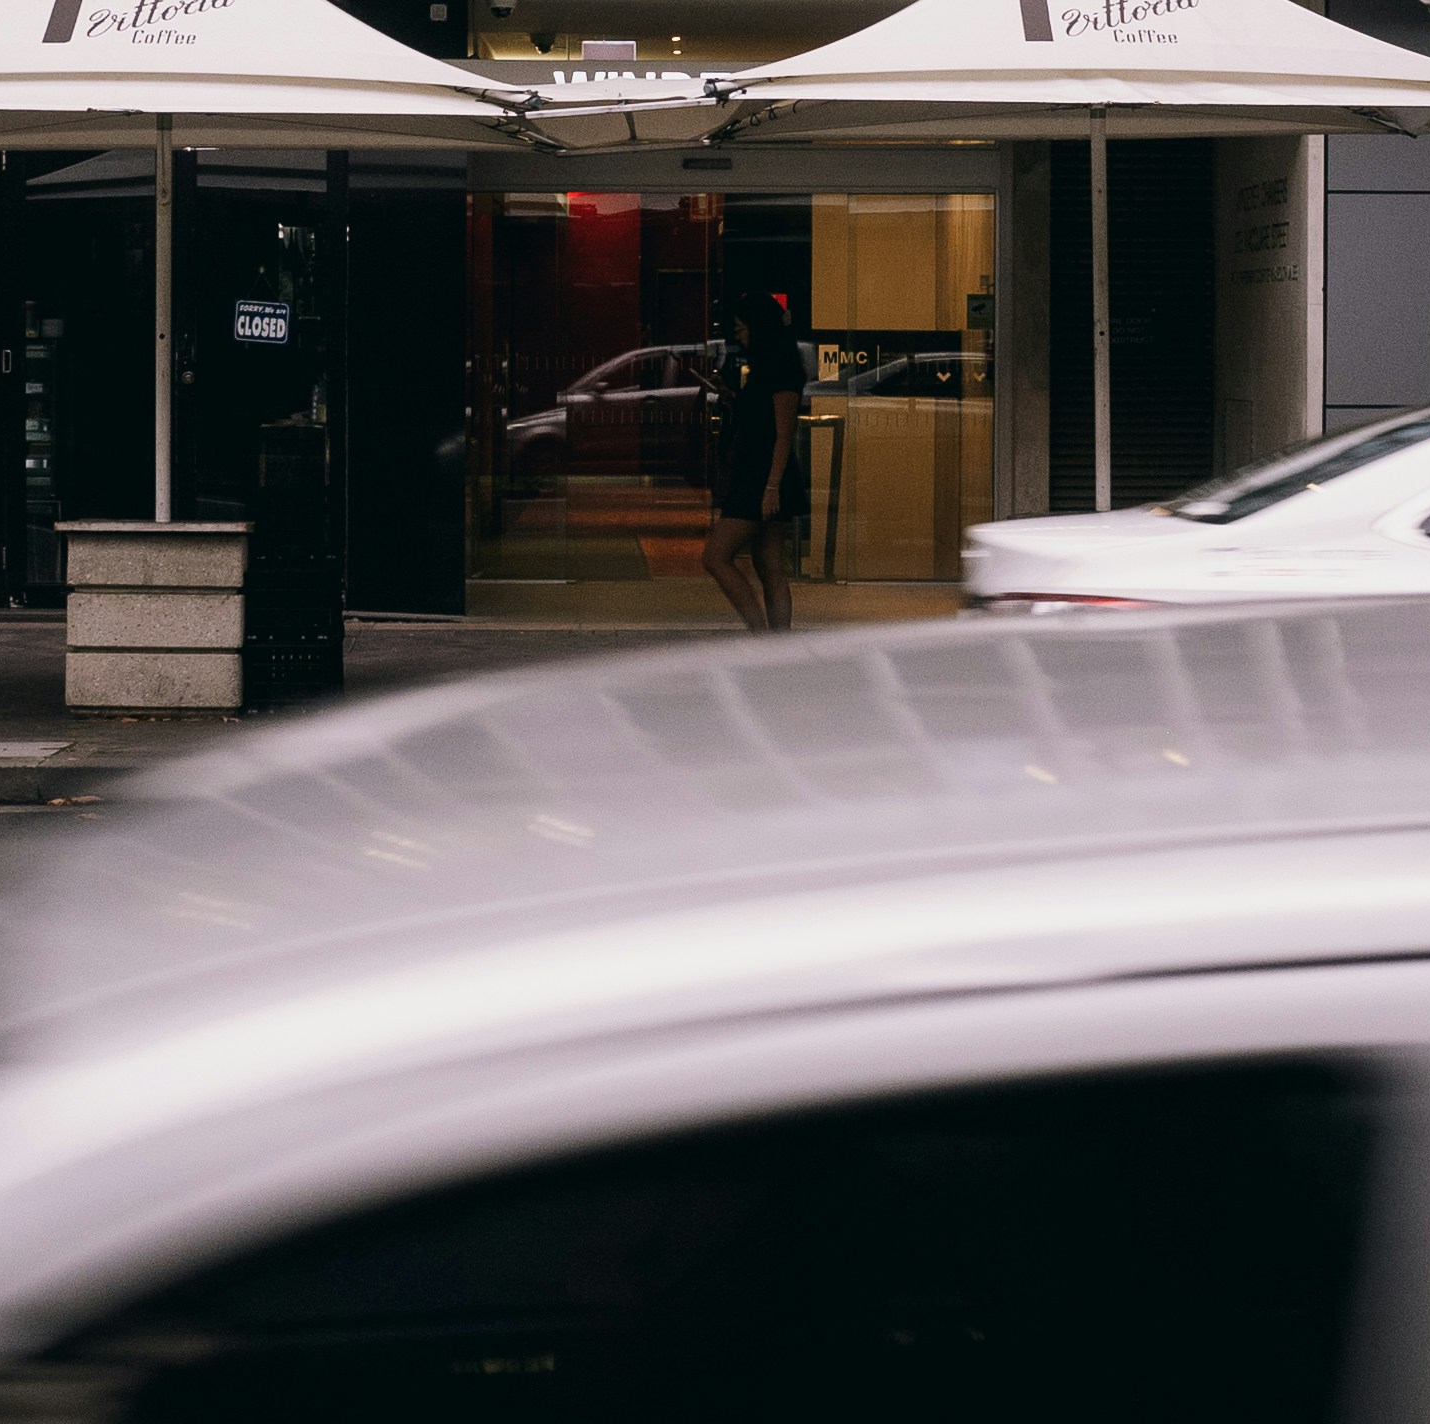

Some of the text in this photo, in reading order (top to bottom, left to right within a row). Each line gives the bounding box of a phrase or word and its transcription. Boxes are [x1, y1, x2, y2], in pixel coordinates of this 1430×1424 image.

[131, 29, 197, 45] Coffee
[1113, 29, 1179, 44] Coffee
[237, 315, 286, 338] CLOSED
[823, 351, 869, 365] MMC
